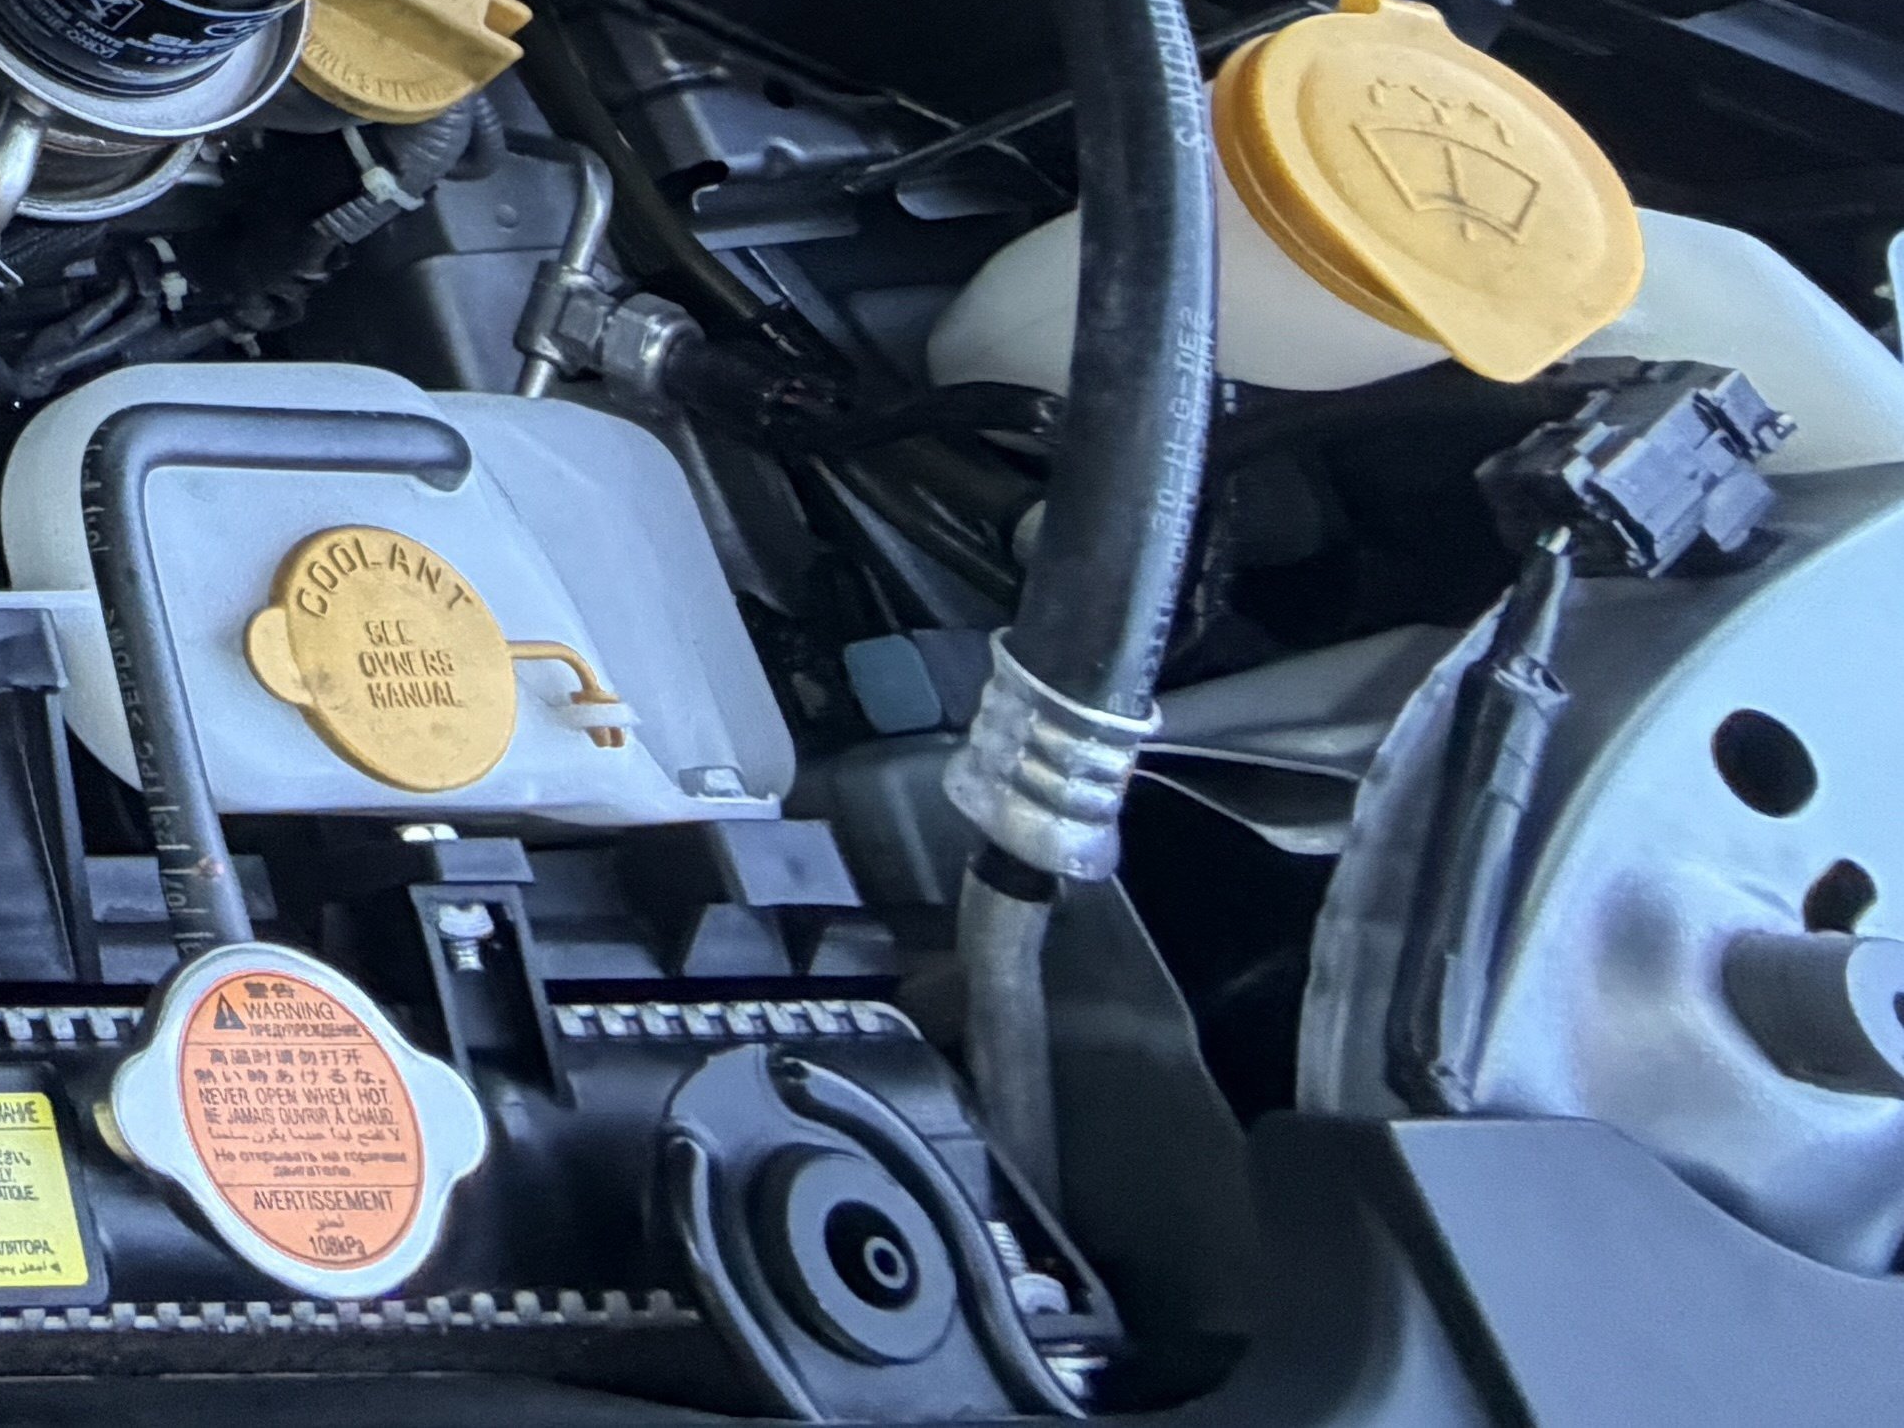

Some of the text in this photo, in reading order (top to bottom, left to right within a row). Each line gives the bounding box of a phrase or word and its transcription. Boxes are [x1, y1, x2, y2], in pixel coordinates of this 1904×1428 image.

[295, 537, 474, 620] COOLANT
[364, 620, 411, 646] SEE
[367, 681, 463, 712] MANUAL
[245, 1001, 336, 1021] WARNING
[198, 1087, 392, 1105] NEVER OPEN WHEN HOT.
[227, 1107, 275, 1125] JAMAIS
[279, 1107, 330, 1125] OUVRIR
[348, 1107, 398, 1125] CHAUD.
[214, 1147, 236, 1162] Не
[253, 1190, 393, 1211] AVERTISSEMENT
[309, 1235, 366, 1257] 108kPa
